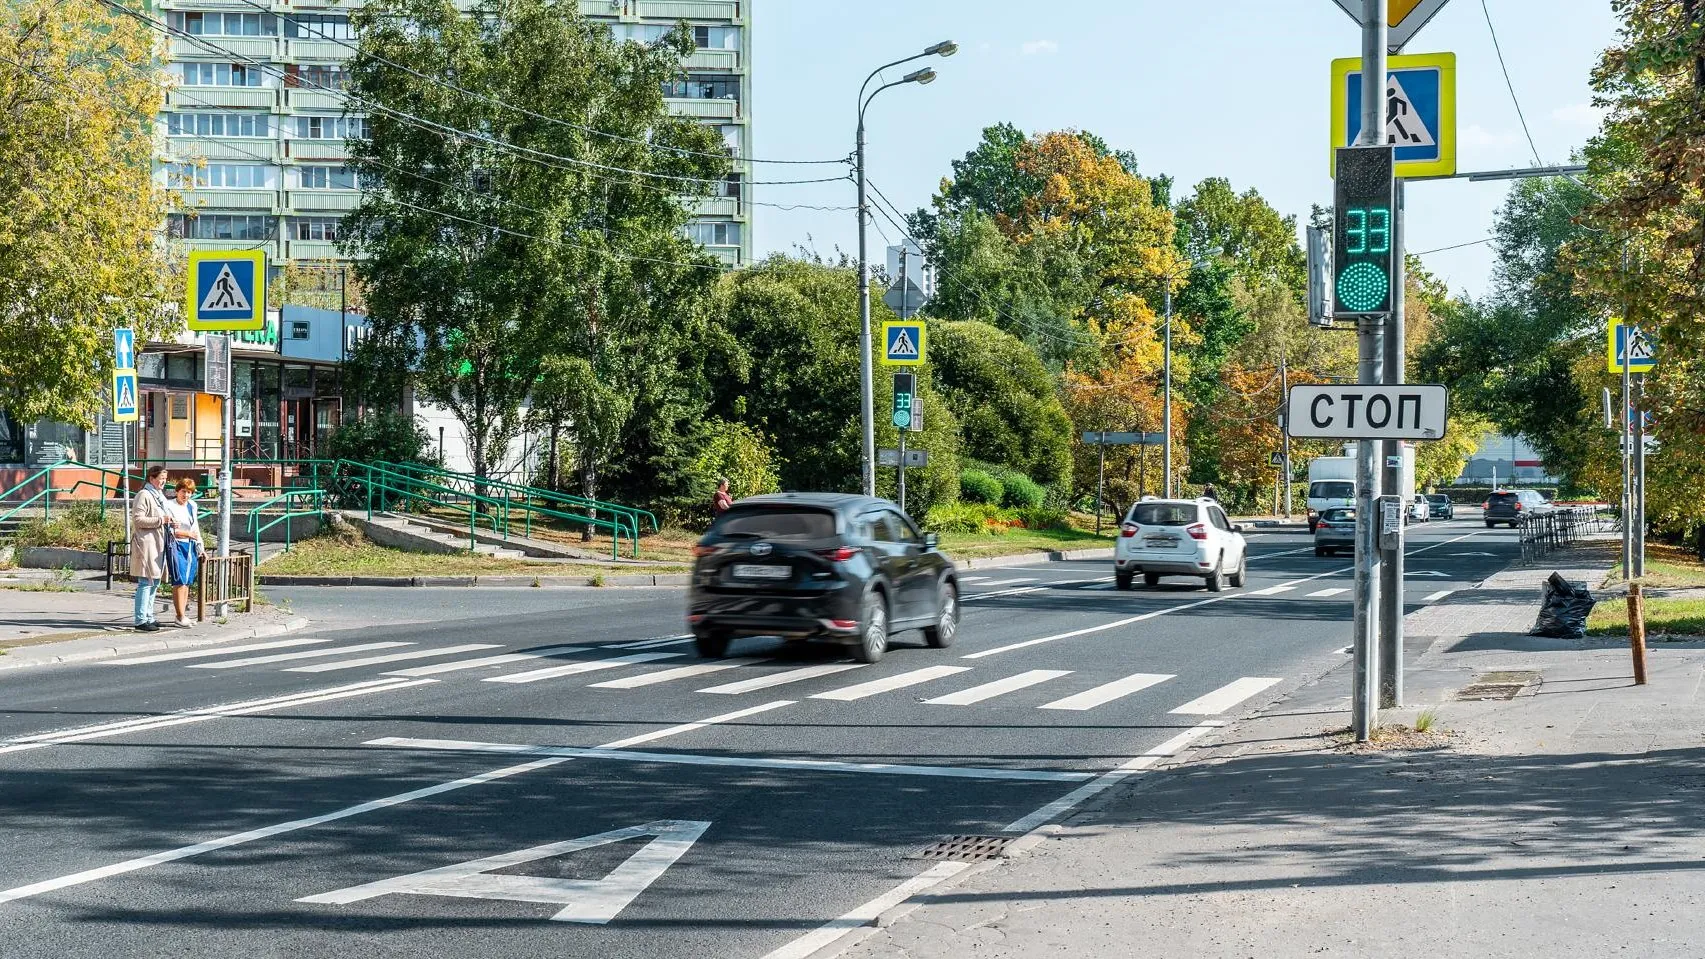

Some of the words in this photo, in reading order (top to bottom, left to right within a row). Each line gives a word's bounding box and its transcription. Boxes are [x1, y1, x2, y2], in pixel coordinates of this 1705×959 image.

[1347, 208, 1389, 253] 33
[896, 392, 912, 409] 33
[1310, 393, 1422, 429] СТОП
